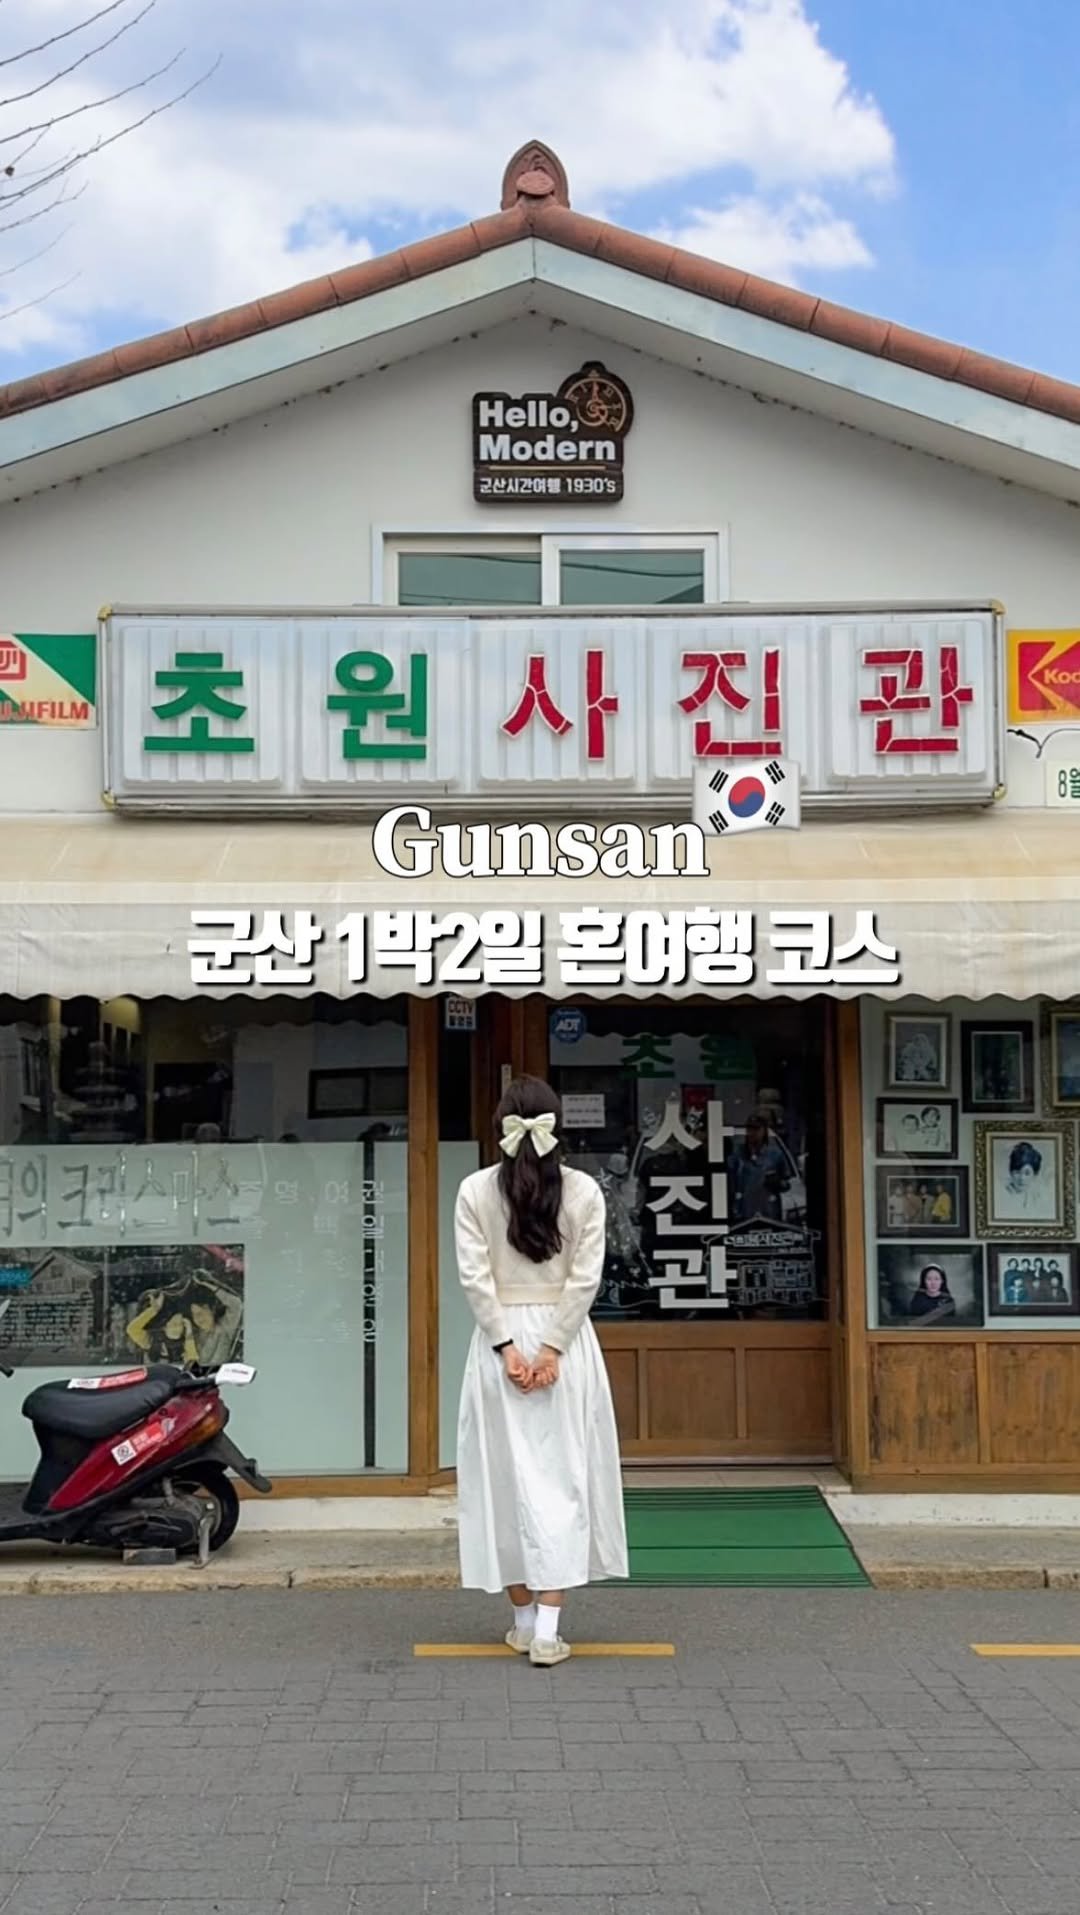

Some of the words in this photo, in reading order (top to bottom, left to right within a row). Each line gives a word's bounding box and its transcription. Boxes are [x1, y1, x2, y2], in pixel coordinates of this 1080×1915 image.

[479, 400, 578, 432] Hello,
[479, 434, 616, 461] Modern
[479, 477, 561, 494] 군산시간여행
[566, 478, 616, 494] 1930's
[448, 1000, 474, 1013] CCTV
[555, 1018, 581, 1032] ADT
[57, 1150, 240, 1238] 크리스마스
[644, 1101, 737, 1309] 사진관
